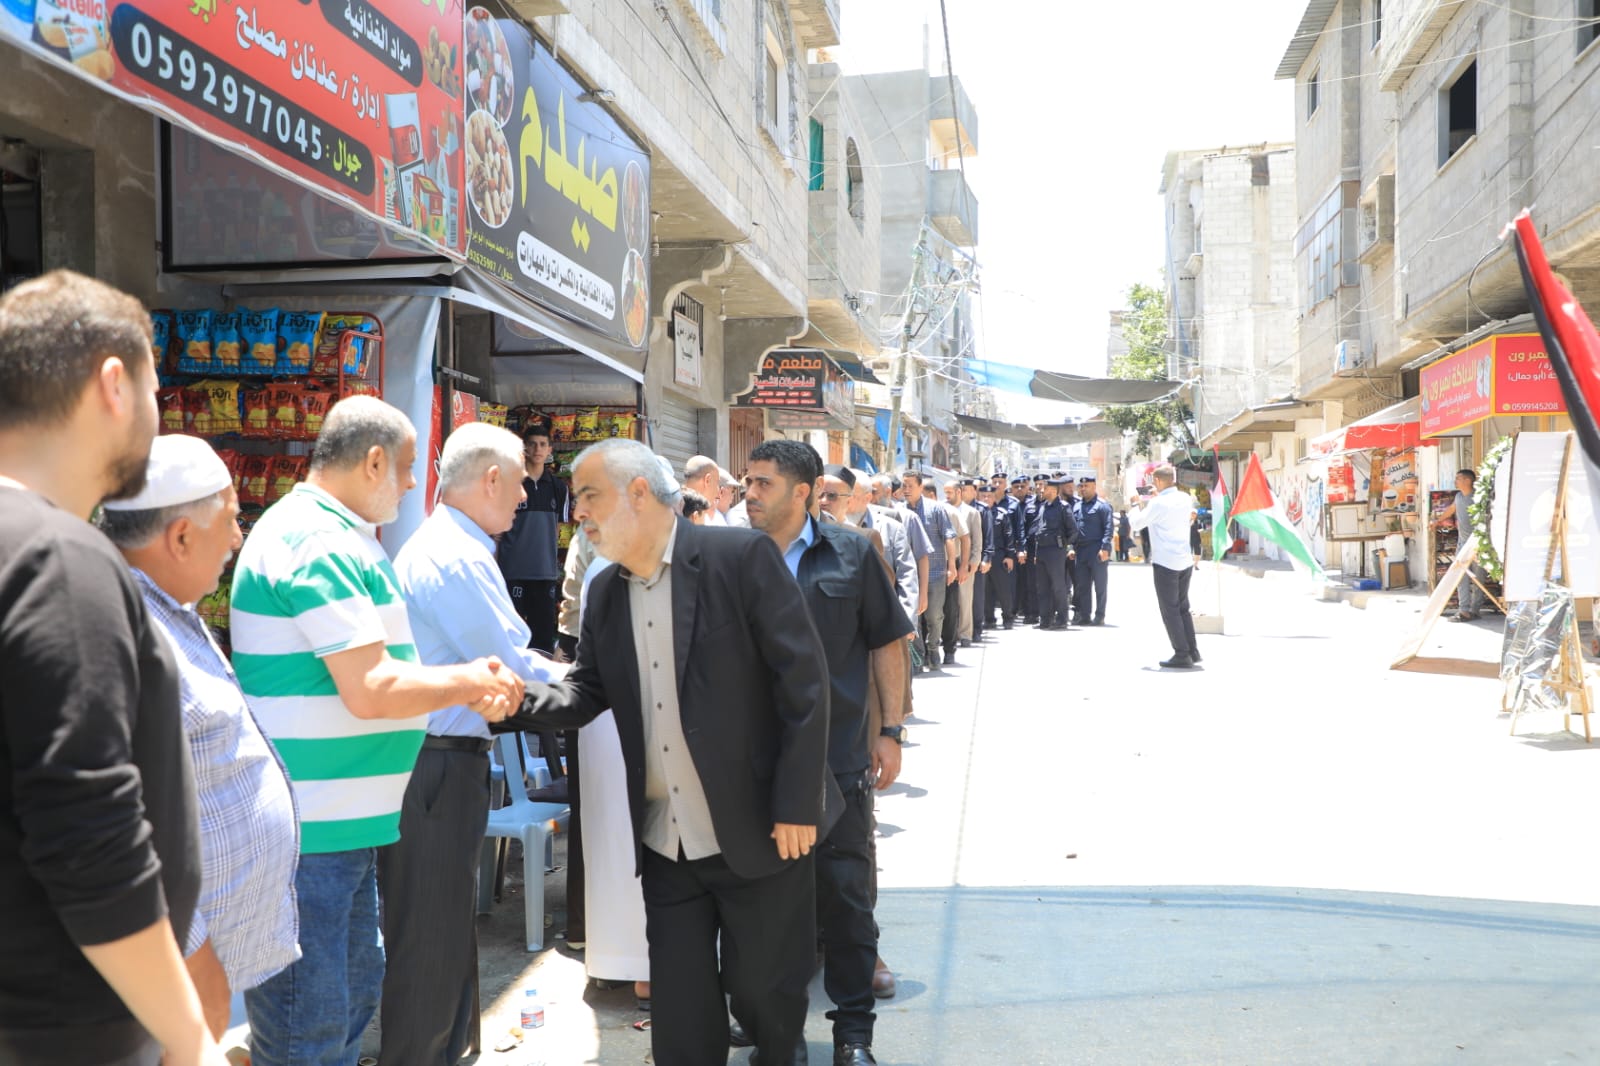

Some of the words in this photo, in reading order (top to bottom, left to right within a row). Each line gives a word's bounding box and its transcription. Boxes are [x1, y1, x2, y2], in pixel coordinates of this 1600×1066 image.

[235, 6, 287, 59] مصلح
[131, 22, 322, 161] 0592977045
[290, 40, 338, 94] عدنان
[332, 137, 362, 183] جوال
[777, 355, 822, 375] مطعم
